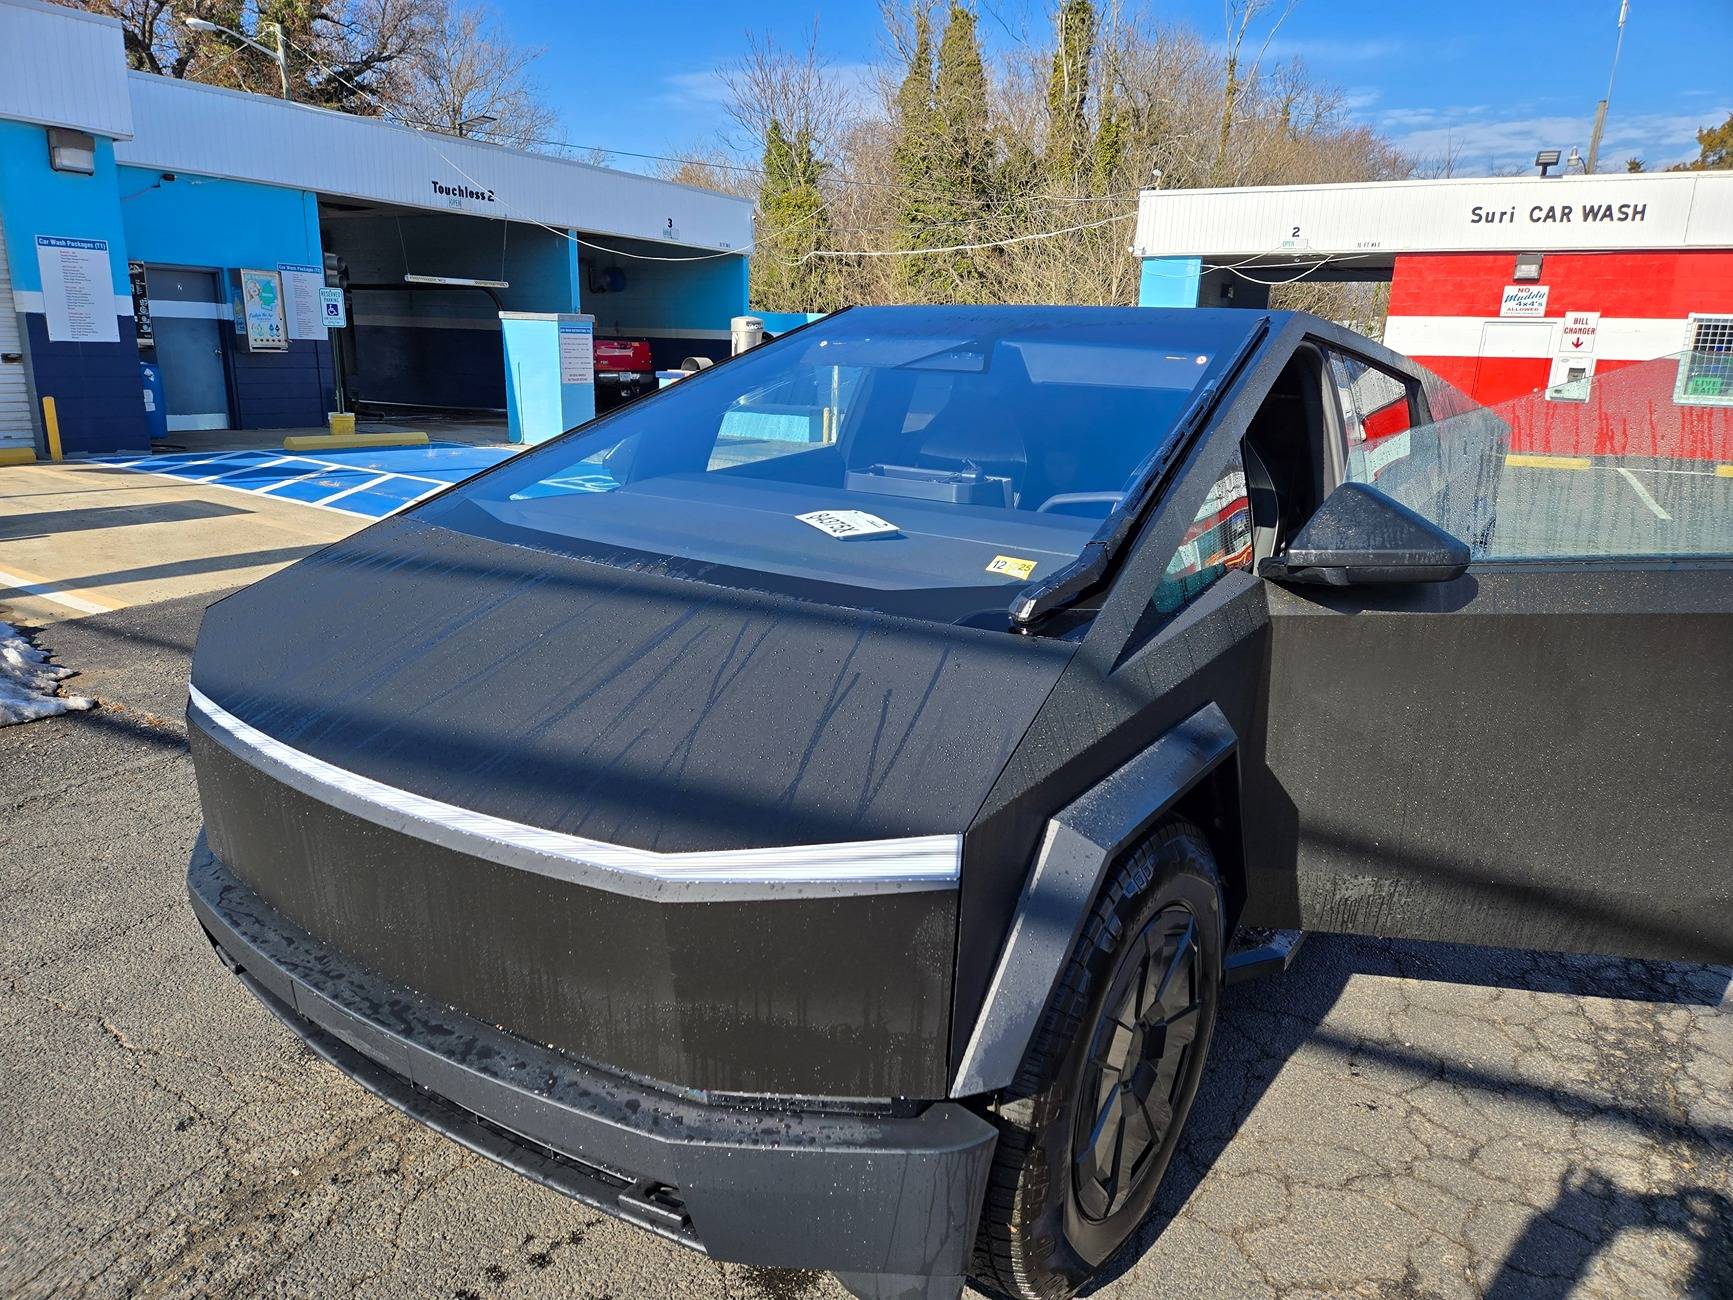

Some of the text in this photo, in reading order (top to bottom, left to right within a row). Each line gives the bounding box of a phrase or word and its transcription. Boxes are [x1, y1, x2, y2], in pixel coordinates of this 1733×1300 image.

[432, 181, 495, 202] Touchless 2
[1471, 204, 1647, 223] Suri CAR WASH
[667, 218, 673, 228] 3
[1292, 226, 1300, 238] 2
[67, 240, 94, 249] Packages
[1504, 291, 1546, 303] Muddy
[1573, 317, 1589, 325] BILL
[1564, 327, 1596, 335] CHANGER
[993, 560, 1032, 571] 12 25
